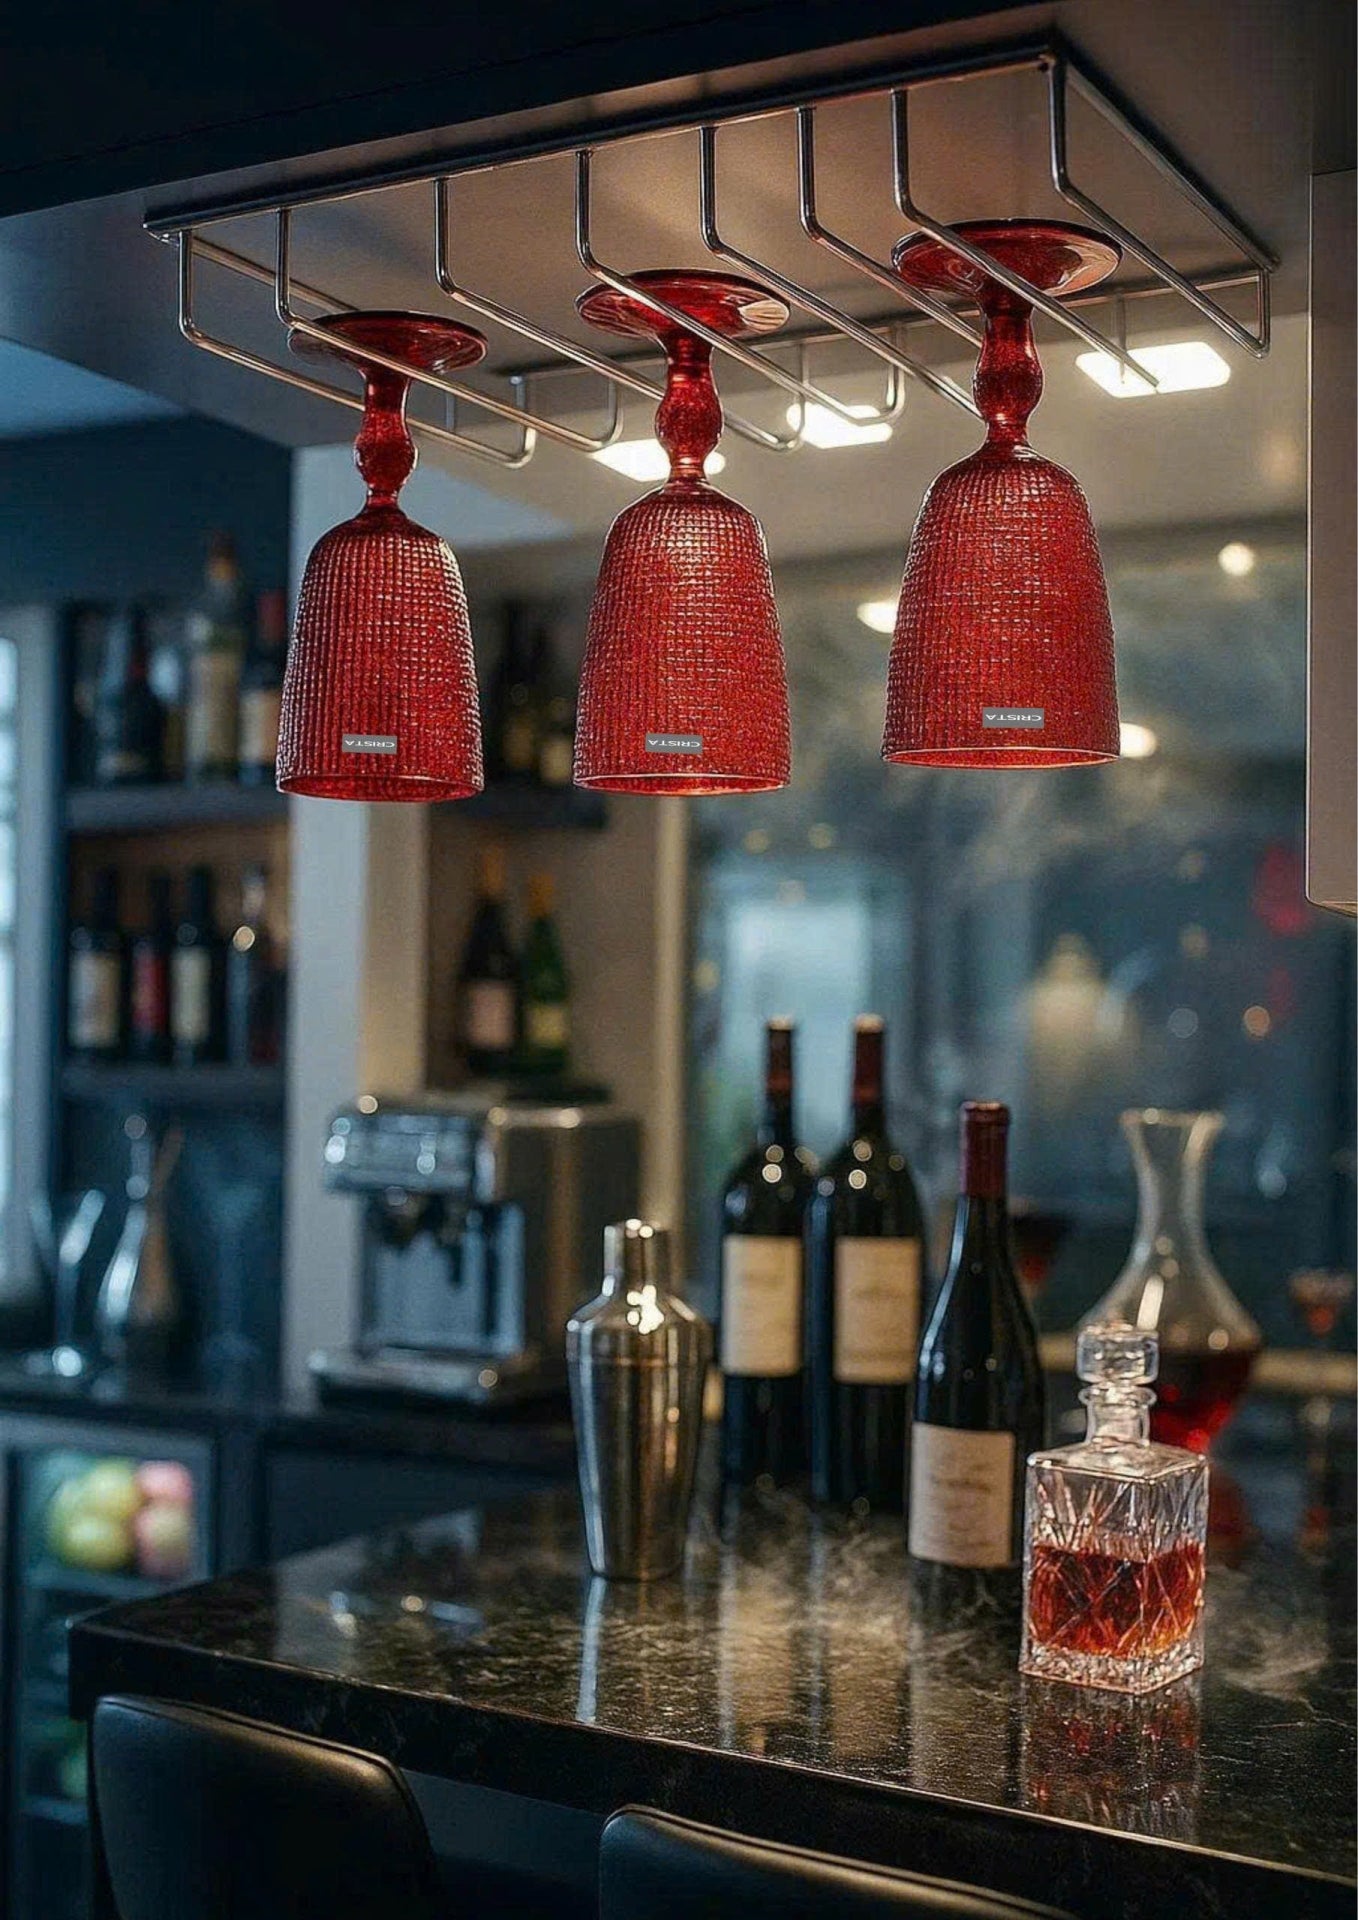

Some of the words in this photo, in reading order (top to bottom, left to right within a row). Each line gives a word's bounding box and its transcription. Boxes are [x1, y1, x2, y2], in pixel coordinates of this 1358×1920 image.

[985, 714, 1042, 722] CRISTA
[344, 739, 396, 748] CRISTA
[648, 739, 701, 748] CRISTA
